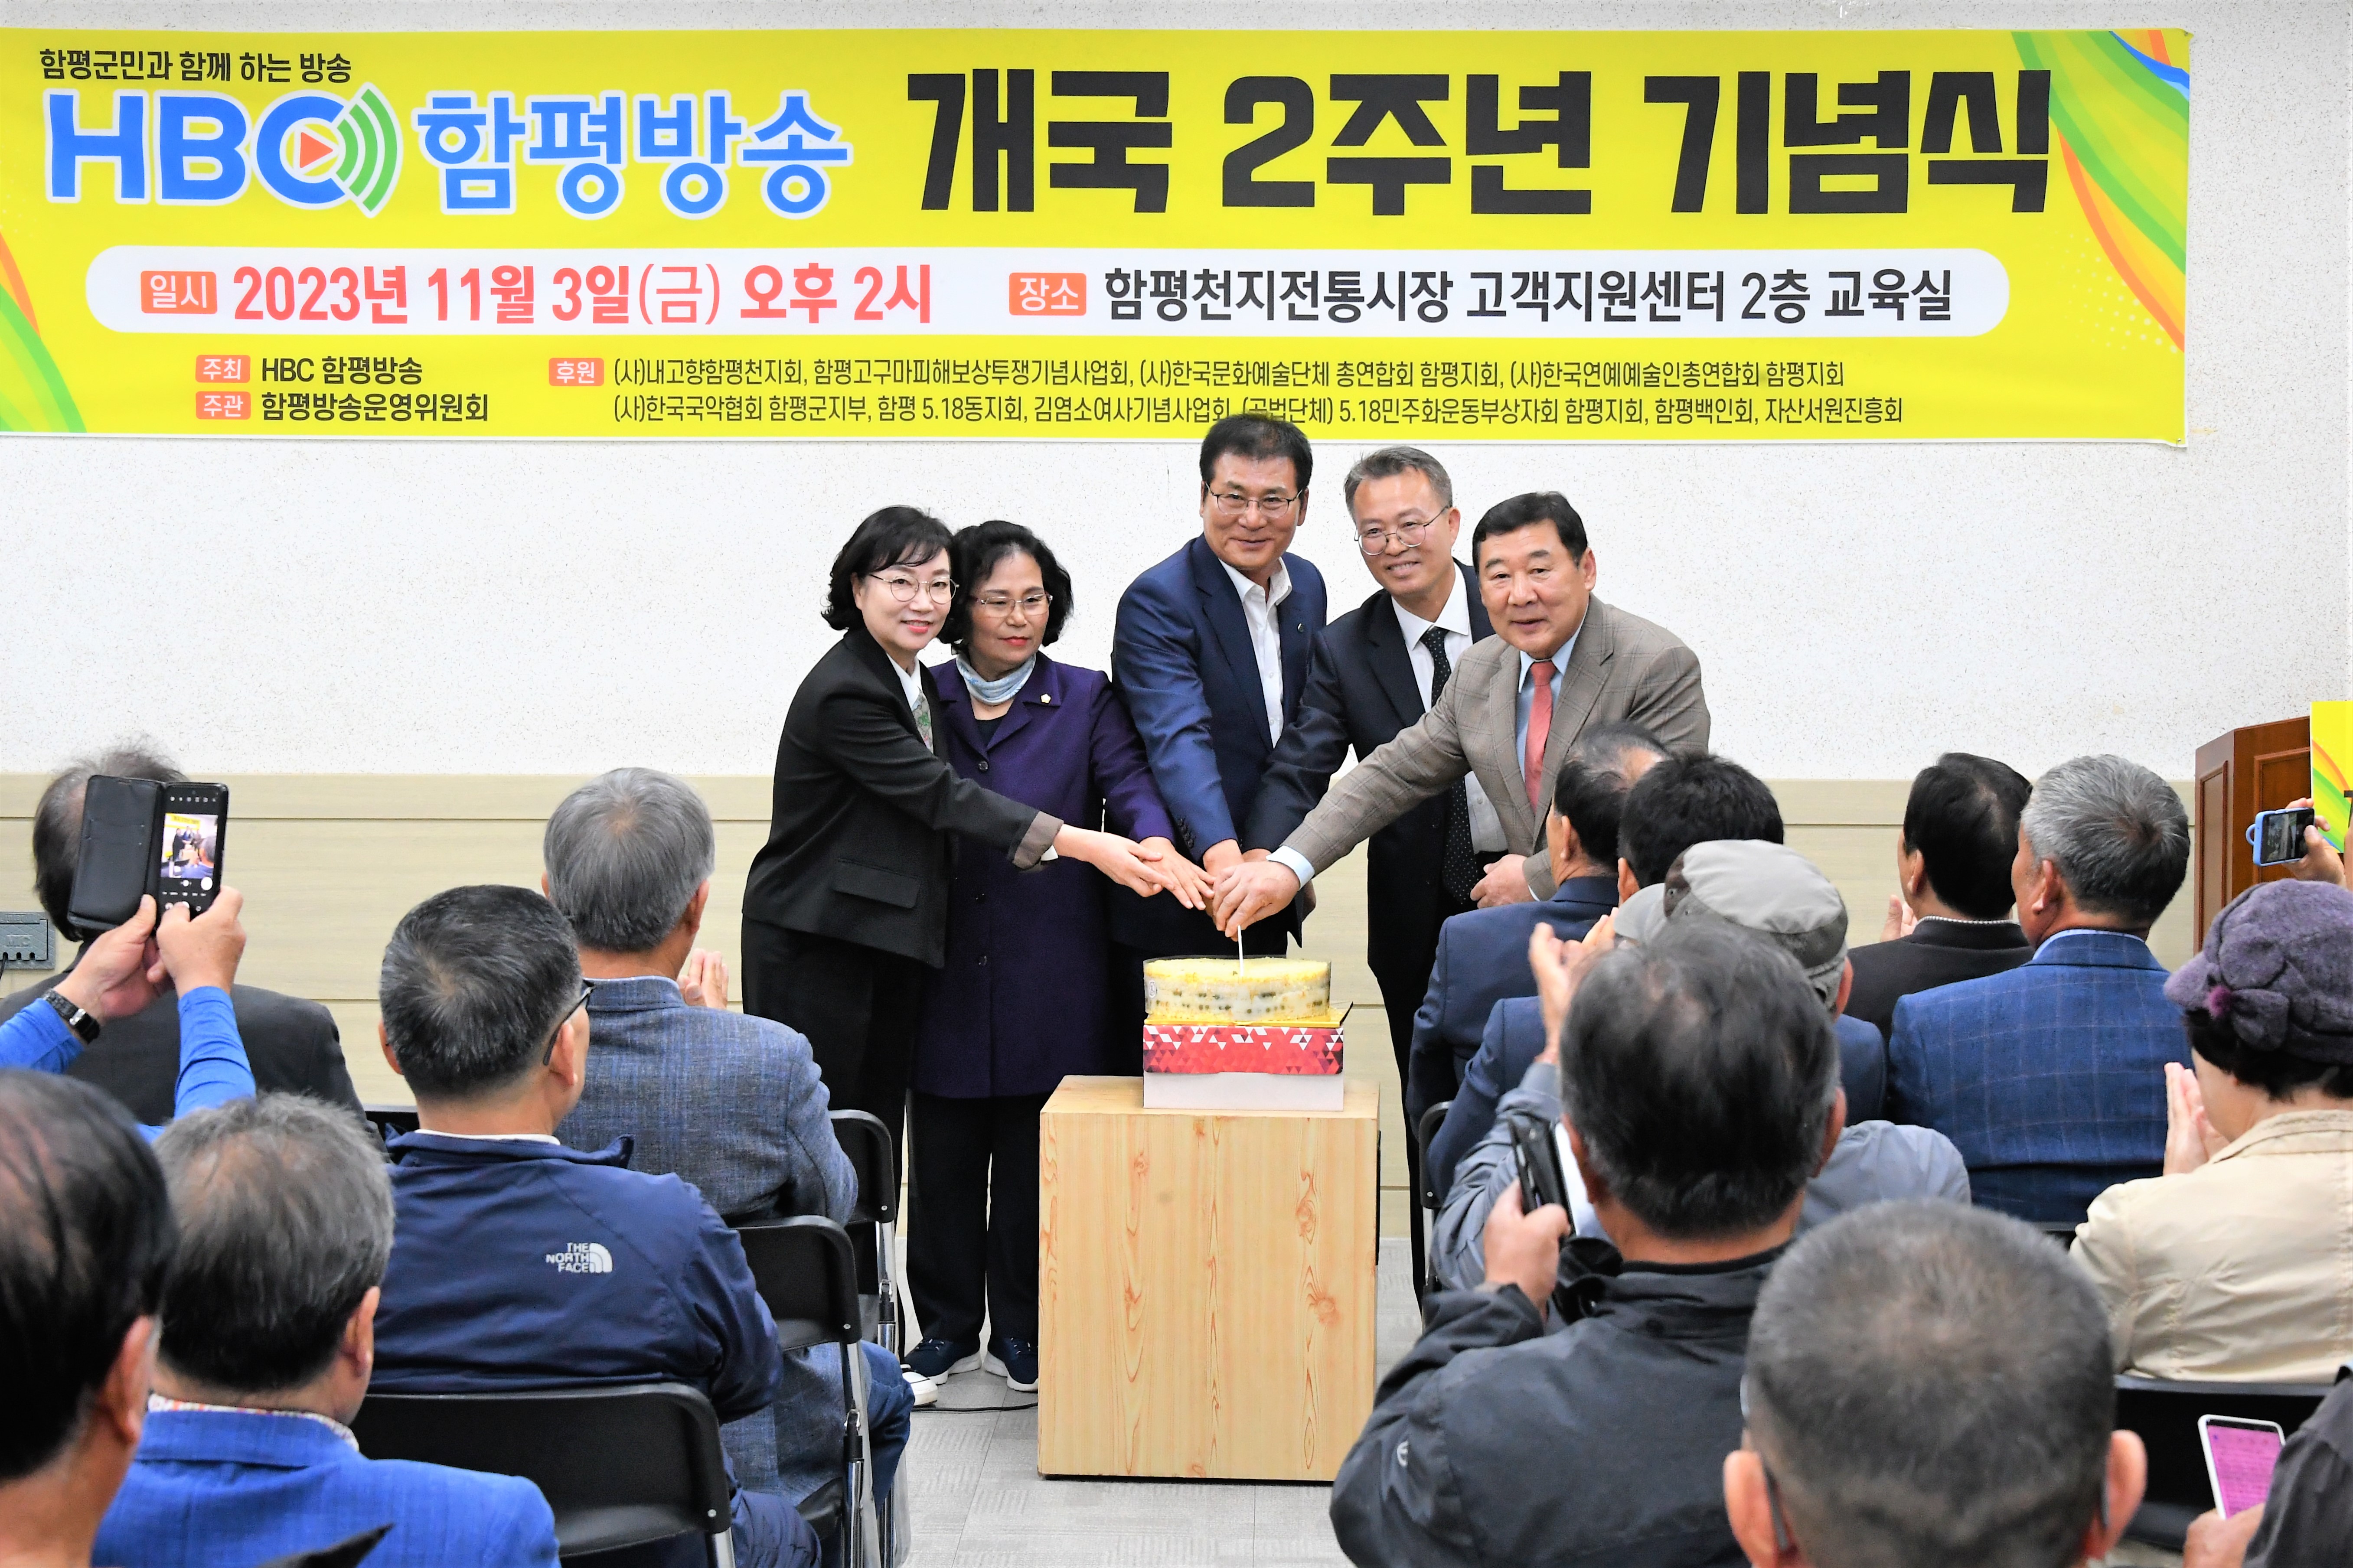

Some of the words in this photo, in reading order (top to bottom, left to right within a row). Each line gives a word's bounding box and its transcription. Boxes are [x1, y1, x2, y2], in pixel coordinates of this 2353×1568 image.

[40, 49, 173, 80] 함평군민과
[179, 51, 230, 81] 함께
[240, 52, 291, 82] 하는
[300, 53, 351, 83] 방송
[49, 94, 346, 204] HBC
[418, 96, 848, 214] 함평방송
[908, 69, 1172, 212] 개국
[1223, 71, 1591, 215] 2주년
[1644, 70, 2051, 214] 기념식
[151, 275, 206, 308] 일시
[234, 266, 407, 323] 2023년
[428, 266, 534, 323] 11월
[553, 264, 719, 324] 3일(금)
[741, 263, 837, 323] 오후
[855, 265, 930, 323] 2시
[1020, 278, 1078, 311] 장소
[1106, 268, 1453, 323] 함평천지전통시장
[1467, 271, 1723, 322] 고객지원센터
[1742, 269, 1810, 323] 2층
[1825, 269, 1950, 320] 교육실
[203, 359, 241, 379] 주최
[263, 359, 314, 381] HBC
[322, 356, 422, 385] 함평방송
[557, 361, 594, 383] 후원
[615, 359, 806, 385] (사)내고향함평천지회,
[814, 359, 1132, 386] 함평고구마피해보상투쟁기념사업회,
[1141, 360, 1328, 387] (사)한국문화예술단체
[1337, 361, 1413, 387] 총연합회
[1421, 362, 1503, 388] 함평지회,
[1511, 361, 1759, 388] (사)한국연예예술인총연합회
[1766, 362, 1843, 387] 함평지회
[204, 395, 243, 417] 주관
[262, 392, 487, 421] 함평방송운영위원회
[615, 395, 761, 422] (사)한국국악협회
[770, 396, 871, 422] 함평군지부,
[878, 396, 915, 421] 함평
[923, 396, 1027, 422] 5.18동지회,
[1340, 398, 1557, 424] 5.18민주화운동부상자회
[1566, 398, 1648, 425] 함평지회,
[1655, 398, 1758, 424] 함평백인회,
[1766, 398, 1901, 423] 자산서원진흥회
[546, 1252, 589, 1263] NORTH
[567, 1242, 589, 1252] THE
[558, 1262, 589, 1273] FACE
